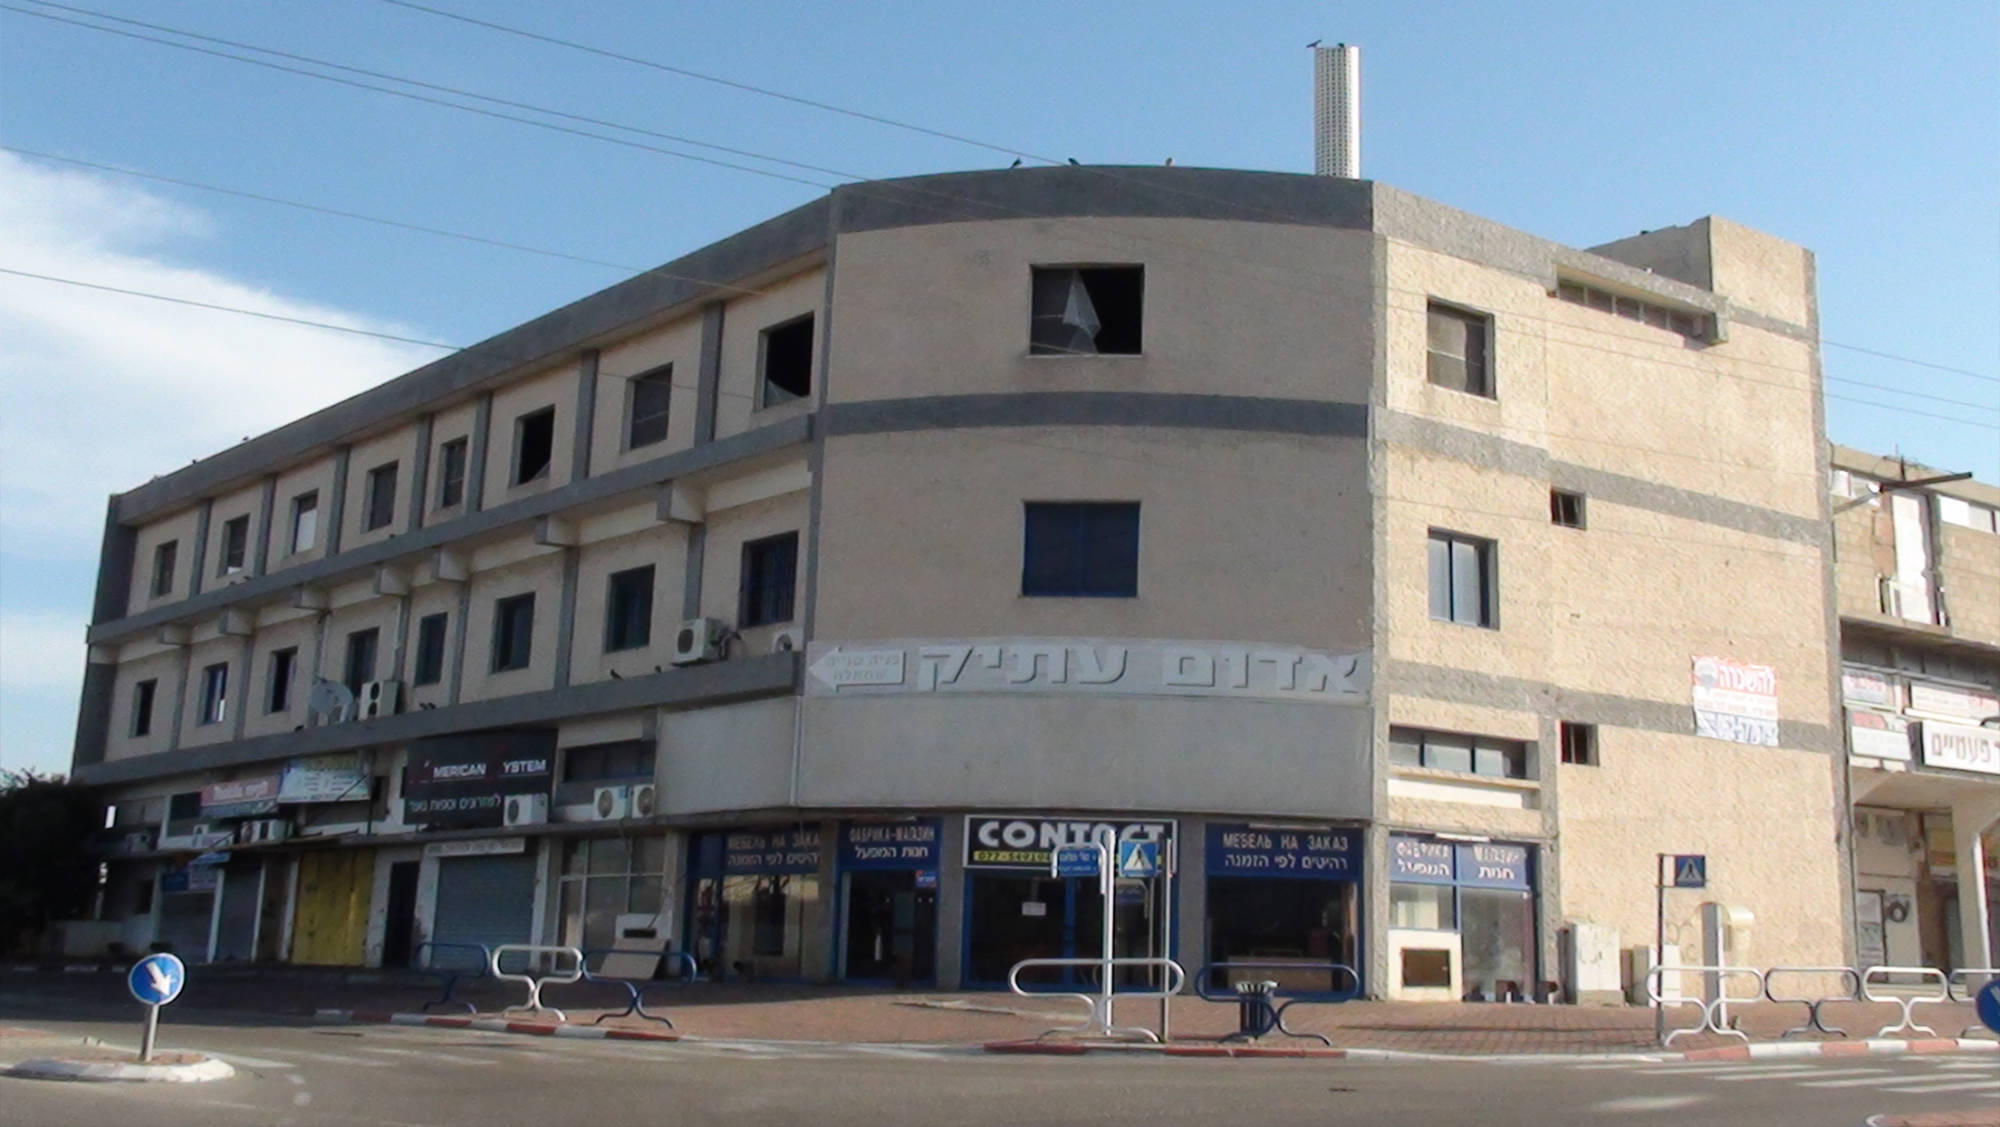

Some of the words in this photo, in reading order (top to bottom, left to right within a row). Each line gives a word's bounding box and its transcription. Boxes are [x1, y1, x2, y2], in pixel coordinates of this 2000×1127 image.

[918, 646, 1128, 693] עתיק
[1161, 648, 1360, 694] אדום
[1931, 732, 1992, 764] פעמיים
[978, 820, 1165, 849] CONTACT
[1222, 833, 1273, 849] МЕБЕЛЬ
[1280, 834, 1299, 850] НА
[1307, 834, 1349, 851] ЗАКАЗ
[1225, 854, 1269, 868] הזמנה
[1274, 852, 1297, 868] לפי
[1301, 855, 1348, 870] רהיטים
